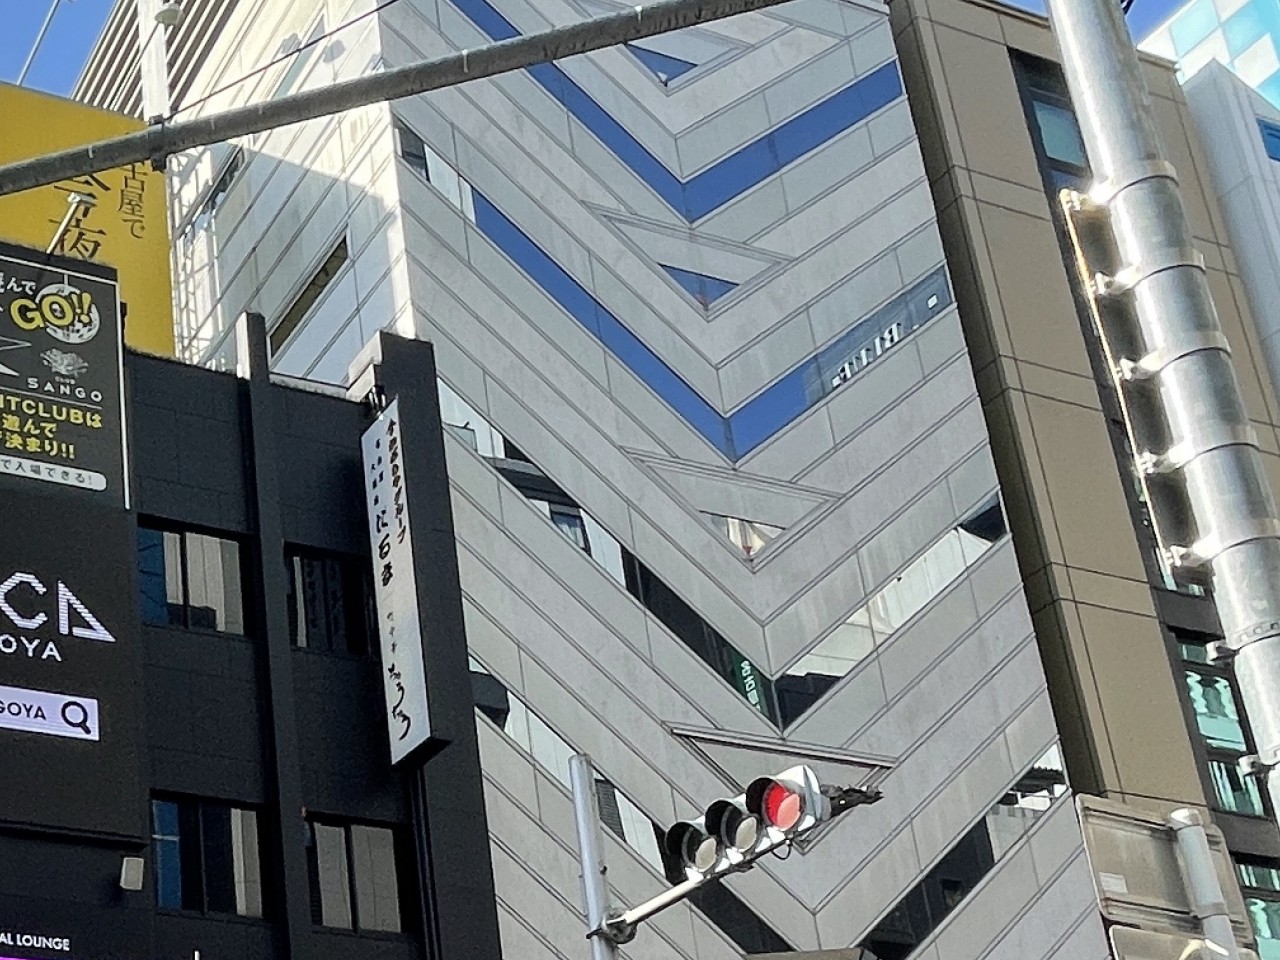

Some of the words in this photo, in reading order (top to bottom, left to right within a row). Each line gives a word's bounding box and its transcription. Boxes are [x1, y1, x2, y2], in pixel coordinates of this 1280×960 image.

[10, 292, 93, 331] GO!!
[26, 376, 103, 403] SANGO
[16, 933, 70, 951] LOUNGE
